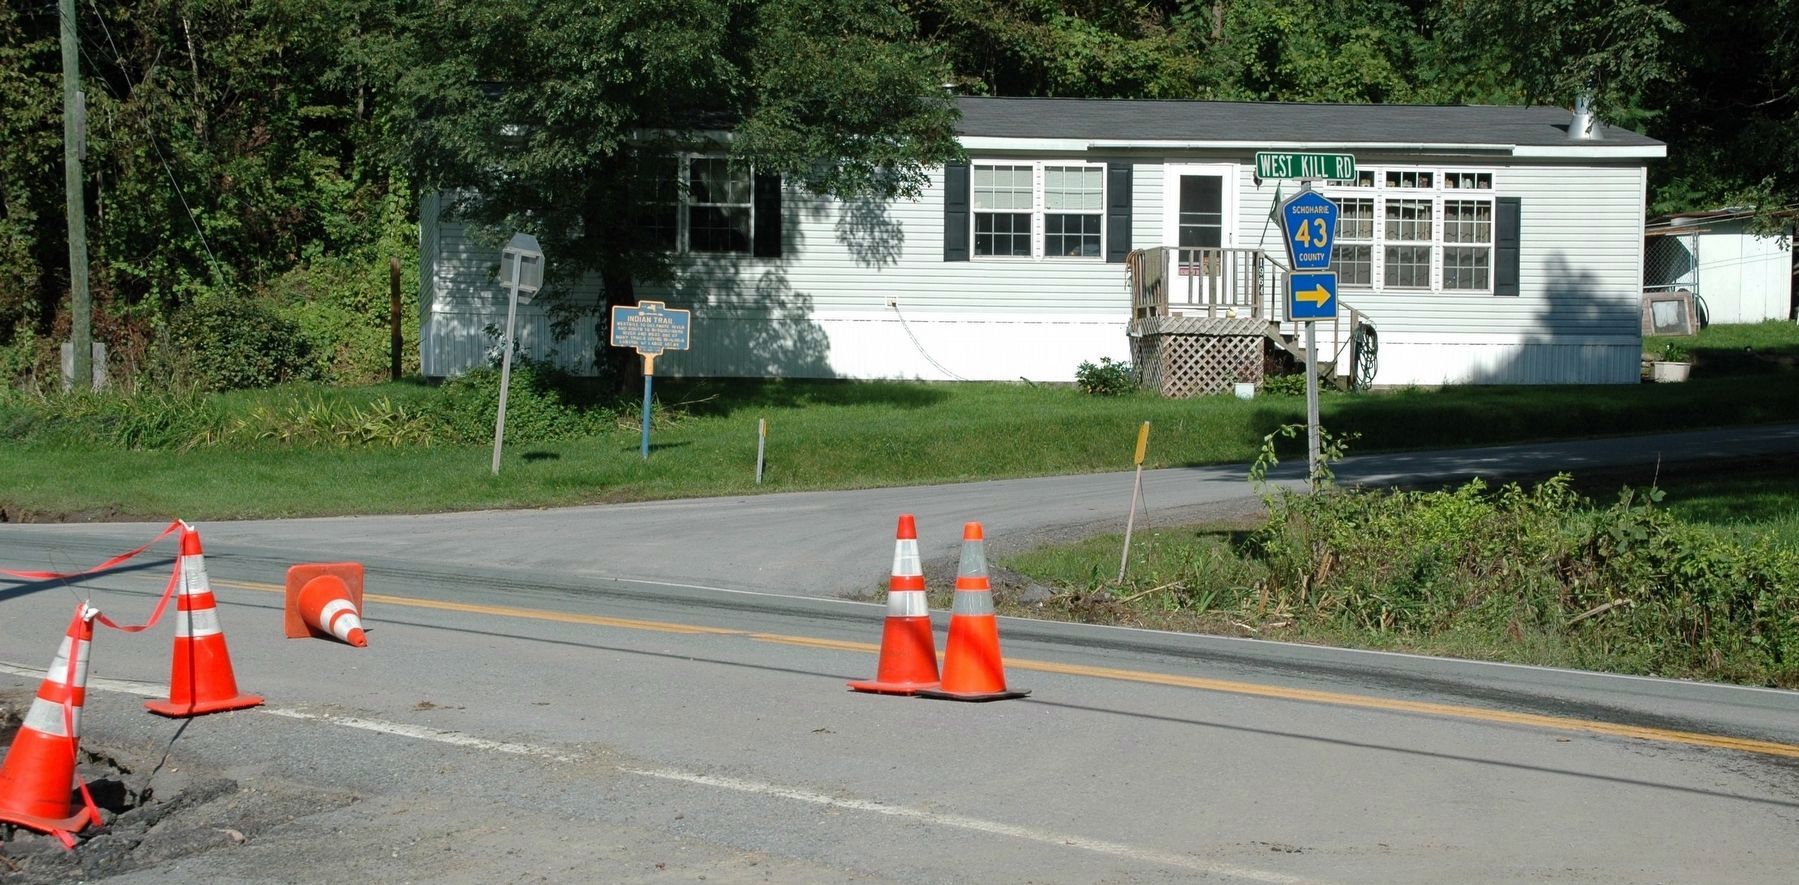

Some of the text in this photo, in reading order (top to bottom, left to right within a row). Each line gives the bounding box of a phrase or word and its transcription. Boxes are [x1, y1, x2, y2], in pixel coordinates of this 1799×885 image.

[1260, 155, 1352, 178] WEST KILL RD
[1292, 205, 1330, 214] SCHOHARIE
[1295, 218, 1328, 248] 43
[1299, 253, 1325, 261] COUNTY
[627, 315, 673, 324] INDIAN TRAIL
